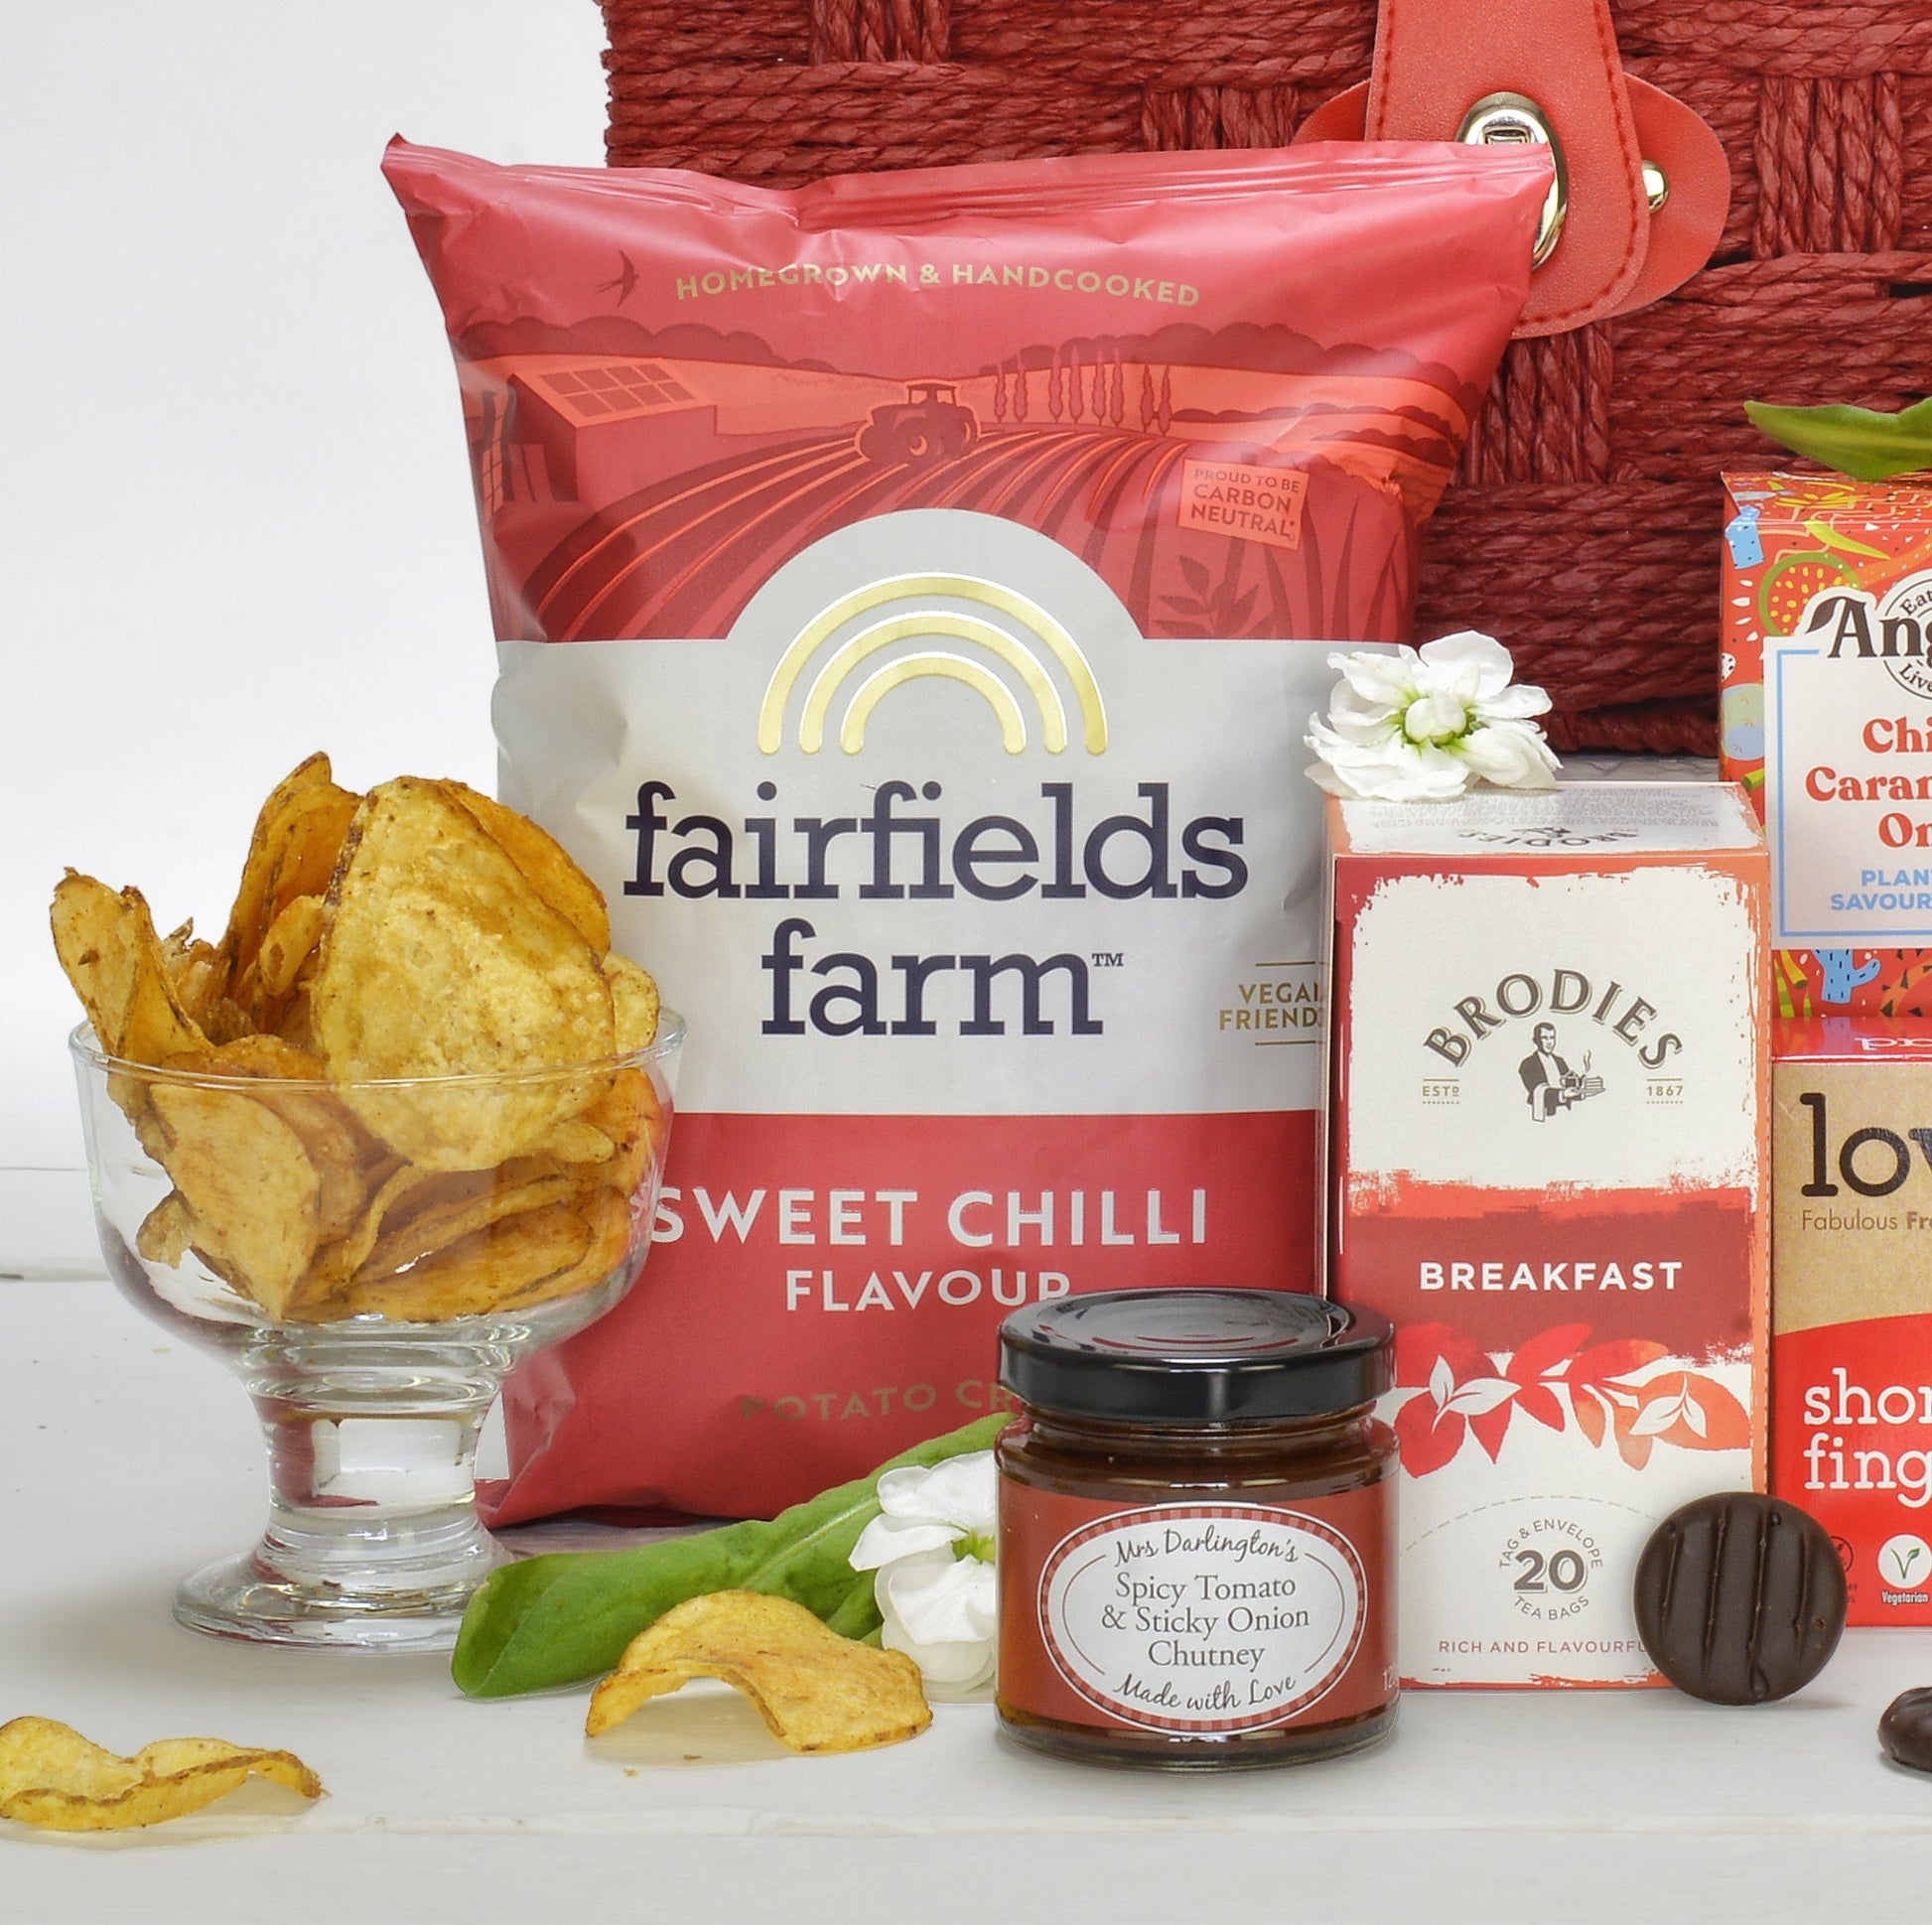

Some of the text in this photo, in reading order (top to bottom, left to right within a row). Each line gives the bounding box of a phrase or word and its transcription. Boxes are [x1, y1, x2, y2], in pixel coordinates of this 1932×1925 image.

[675, 262, 1200, 307] HOMEGROWN & HANDCOOKED
[1193, 484, 1292, 514] CARBON
[1194, 470, 1301, 493] PROUD TO BE
[1806, 596, 1932, 669] An
[622, 779, 1249, 899] fairfields
[1862, 870, 1932, 887] PLAN
[1423, 969, 1683, 1070] BRODIES
[1647, 1085, 1683, 1096] 1867
[651, 1187, 1206, 1248] SWEET CHILLI
[1802, 1208, 1932, 1230] Fabulous Fr
[1419, 1261, 1683, 1291] BREAKFAST
[740, 1384, 936, 1422] POTATO
[1115, 1524, 1299, 1568] Mrs Darlington's
[1499, 1519, 1603, 1569] TAG & ENVELOPE
[1115, 1572, 1297, 1606] Spicy Tomato
[1514, 1550, 1588, 1593] 20
[1514, 1595, 1589, 1620] TEA BAGS
[1881, 1590, 1929, 1606] Vegetarian
[1101, 1604, 1311, 1641] & Sticky Onion
[1149, 1639, 1265, 1672] Chutney
[1439, 1640, 1482, 1653] RICH
[1490, 1640, 1529, 1653] AND
[1114, 1673, 1297, 1711] Made with Love
